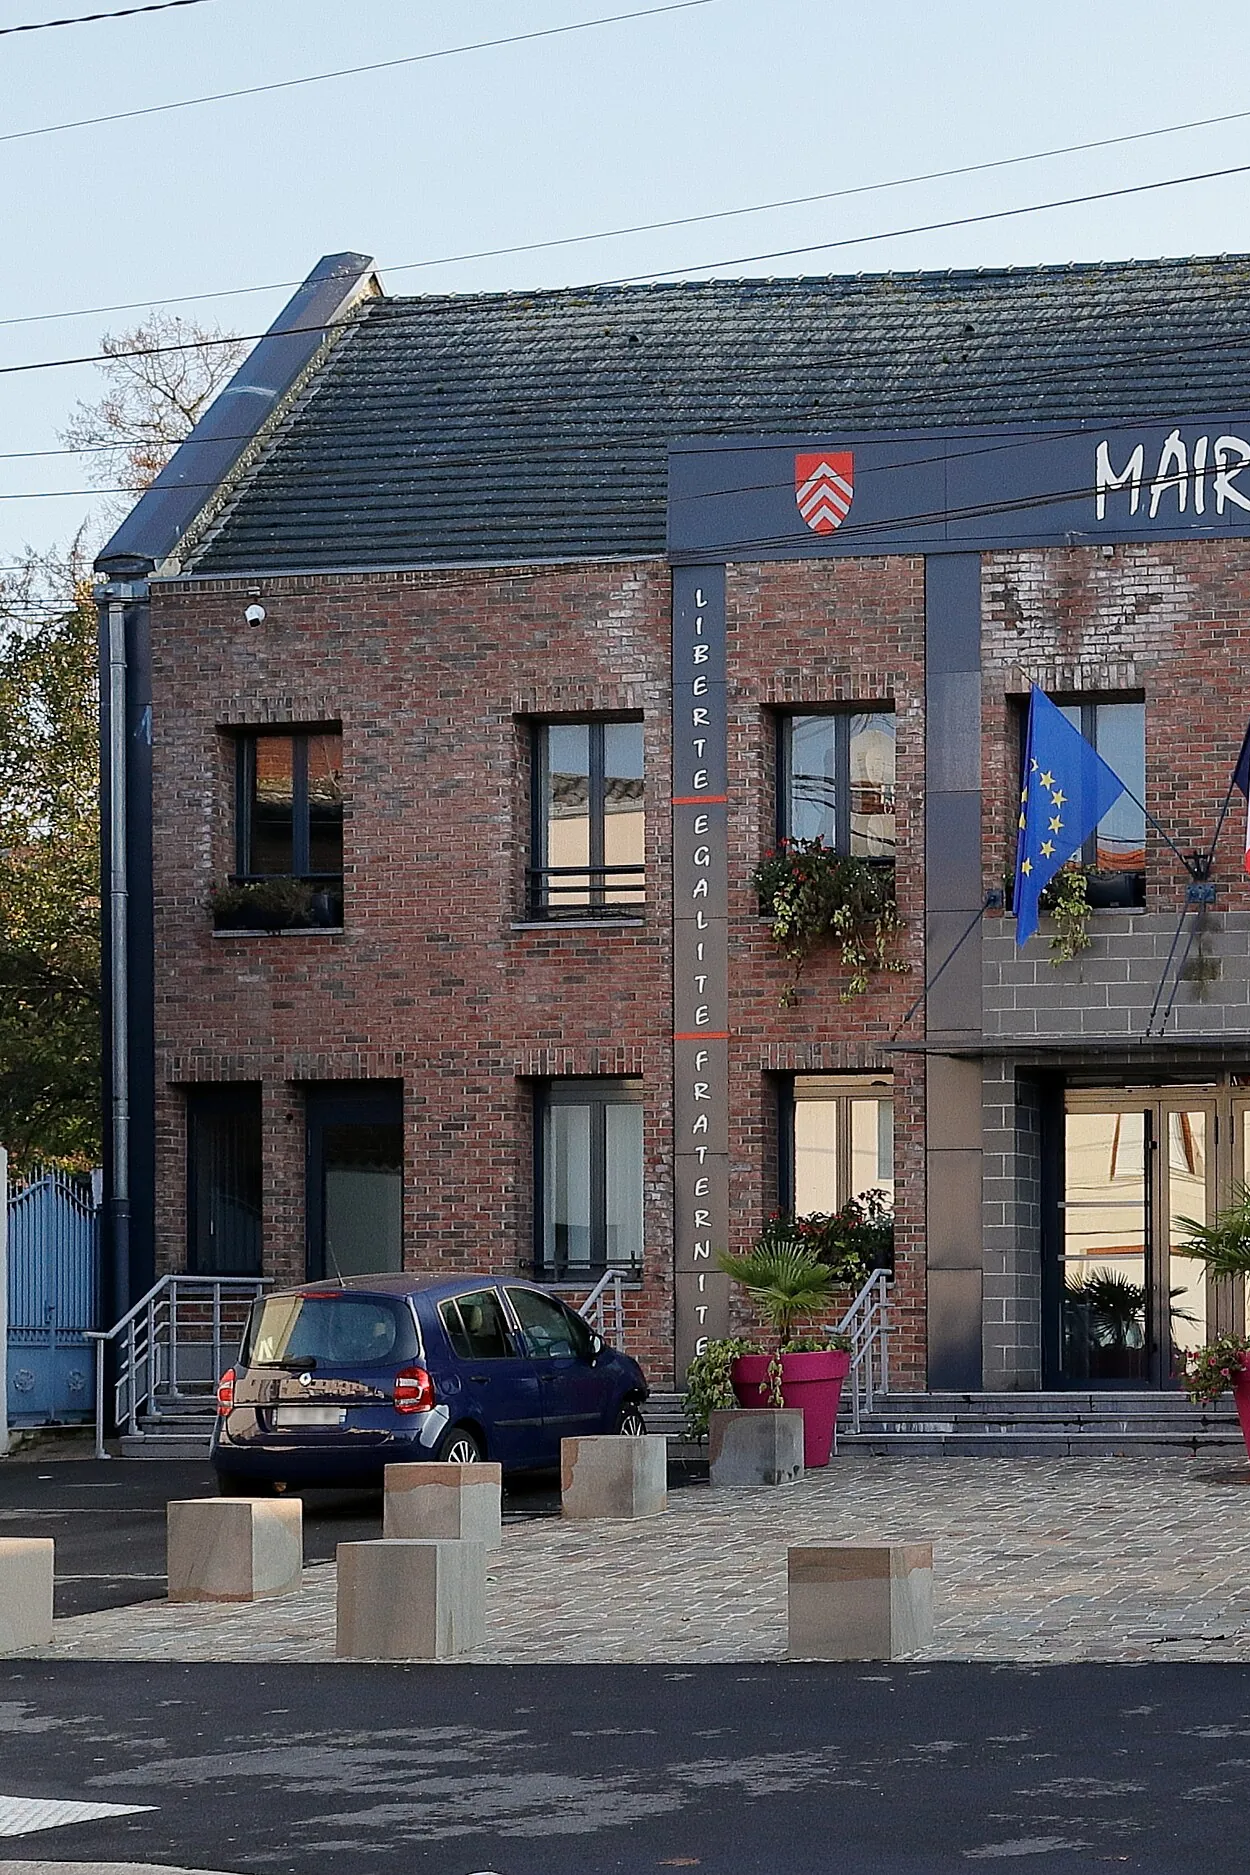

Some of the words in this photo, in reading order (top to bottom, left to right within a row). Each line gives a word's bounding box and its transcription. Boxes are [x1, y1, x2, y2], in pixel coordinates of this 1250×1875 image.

[692, 588, 711, 791] LIBERTE
[692, 813, 711, 1026] EGALITE
[692, 1050, 713, 1357] FRATERNITE
